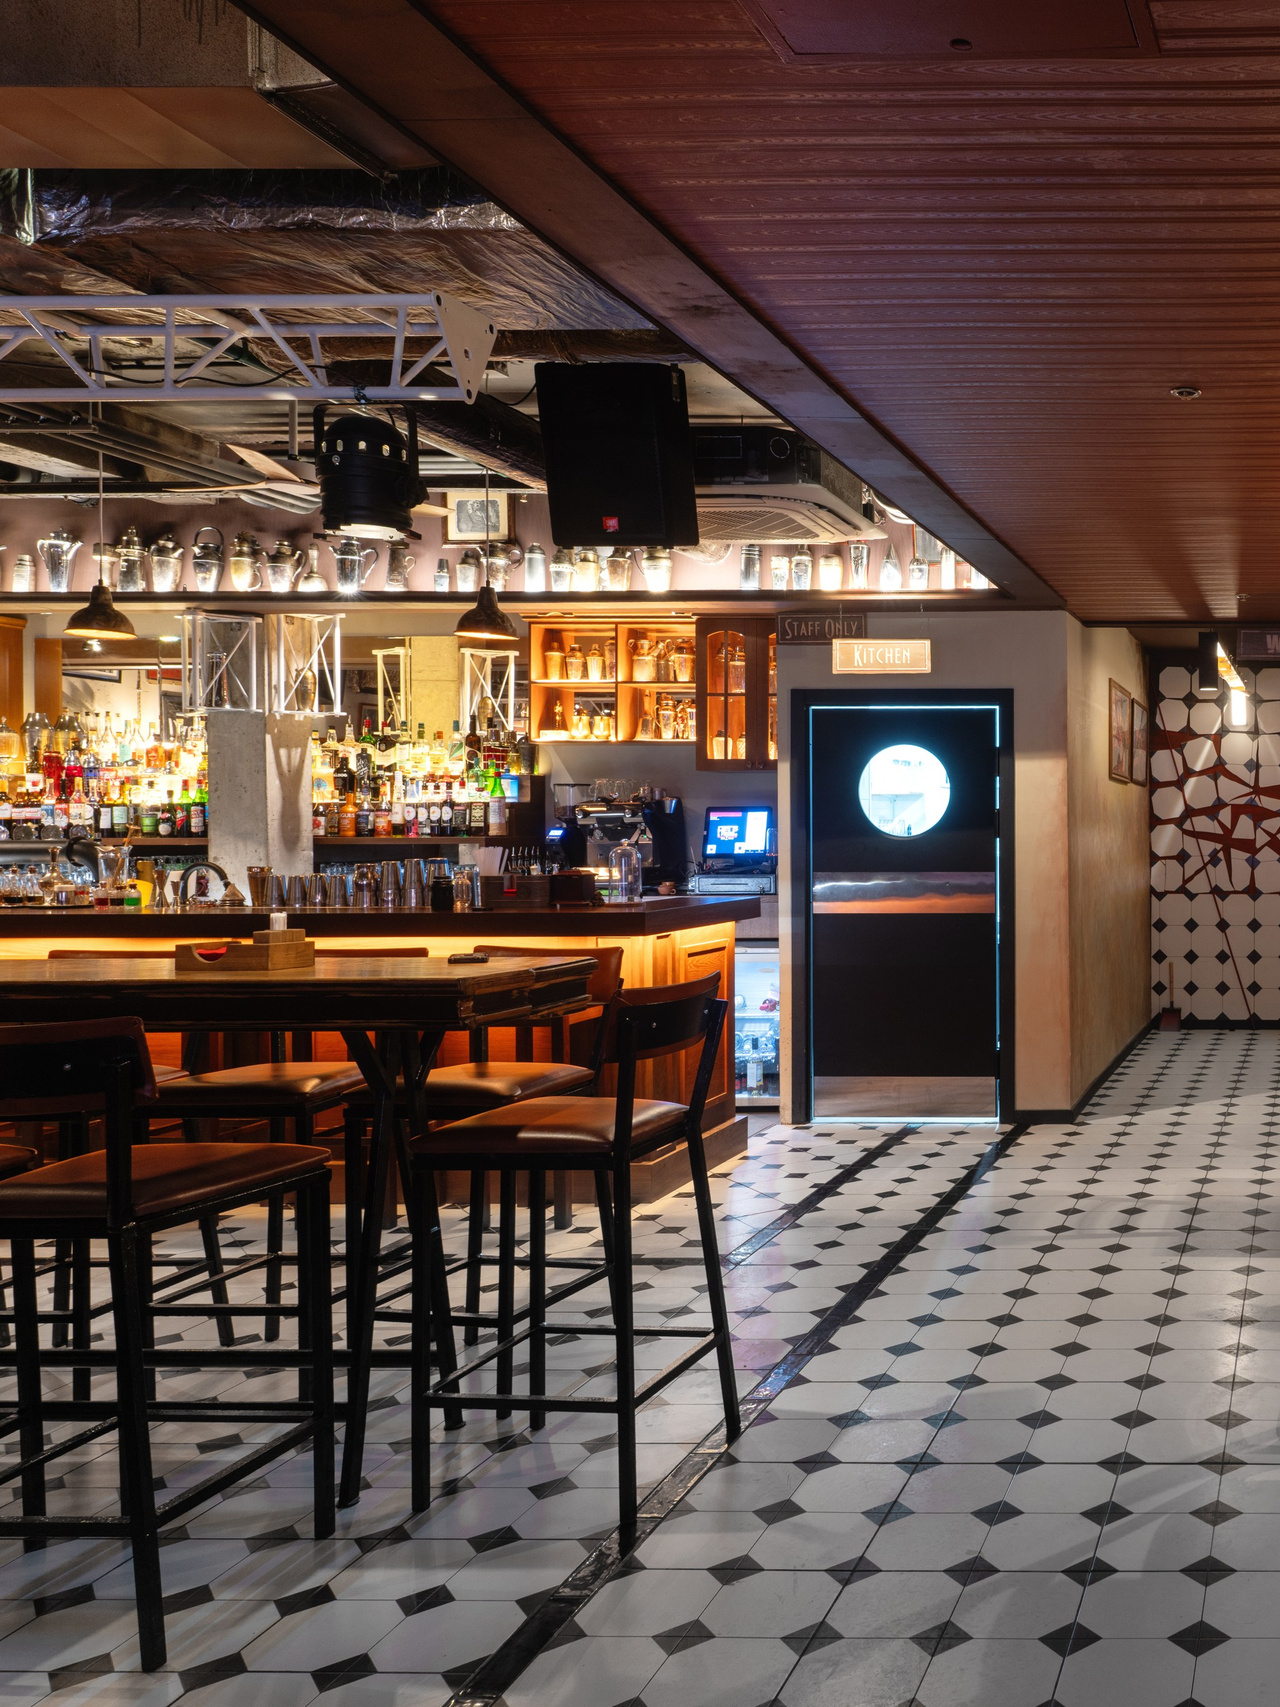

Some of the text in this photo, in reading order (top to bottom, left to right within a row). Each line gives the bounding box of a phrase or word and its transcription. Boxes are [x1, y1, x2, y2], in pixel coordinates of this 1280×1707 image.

[785, 618, 858, 639] STAFF ONLY
[854, 645, 911, 667] KITCHEN
